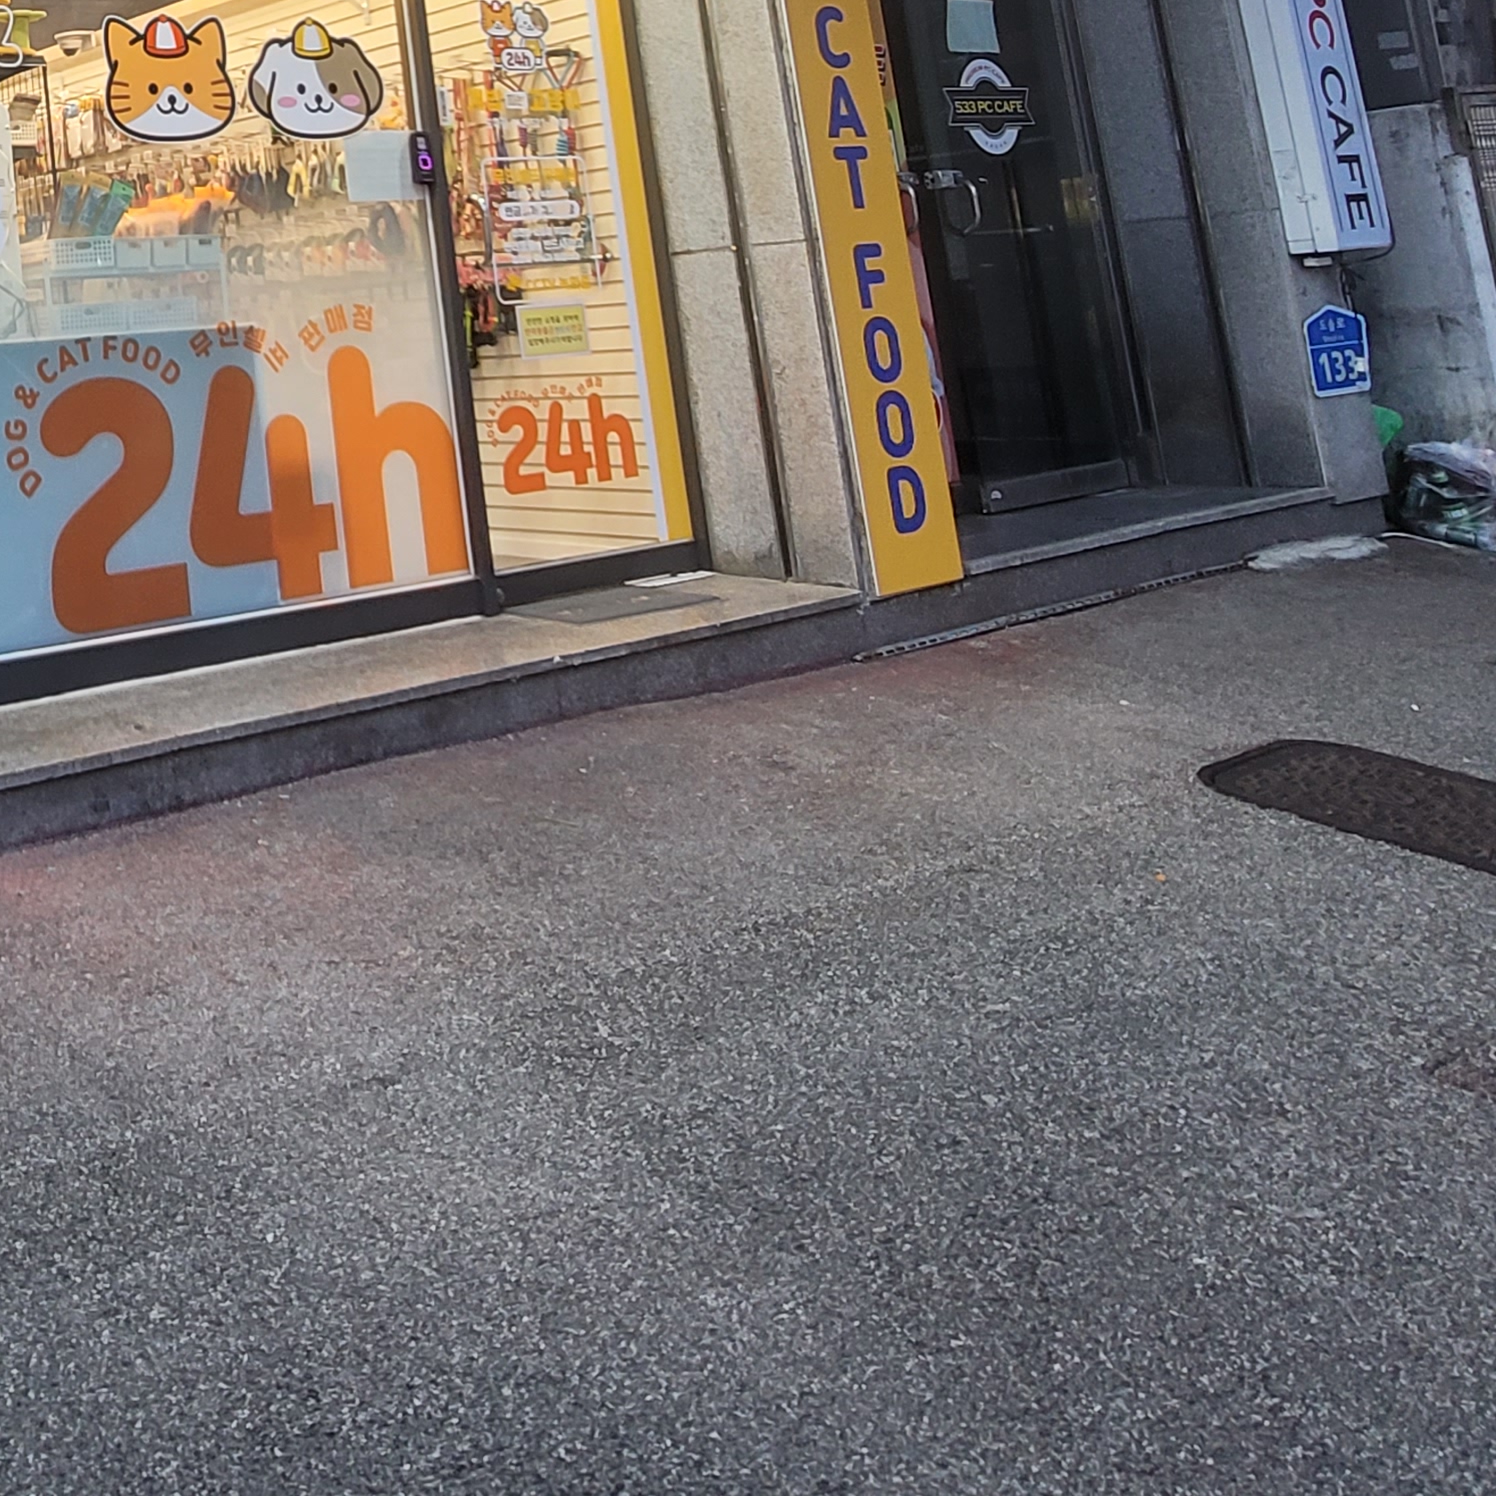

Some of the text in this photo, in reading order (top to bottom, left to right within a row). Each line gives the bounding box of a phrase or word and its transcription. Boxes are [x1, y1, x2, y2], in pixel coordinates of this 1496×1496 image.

[506, 51, 531, 67] 24h
[954, 100, 1025, 113] 533 PC CAFE
[1319, 65, 1376, 232] CAFE
[813, 4, 870, 209] CAT
[852, 243, 927, 534] FOOD
[4, 303, 374, 498] DOG & CAT FOOD 무인셀프 판매점
[1318, 349, 1359, 383] 133
[40, 346, 470, 635] 24h
[497, 392, 639, 495] 24h
